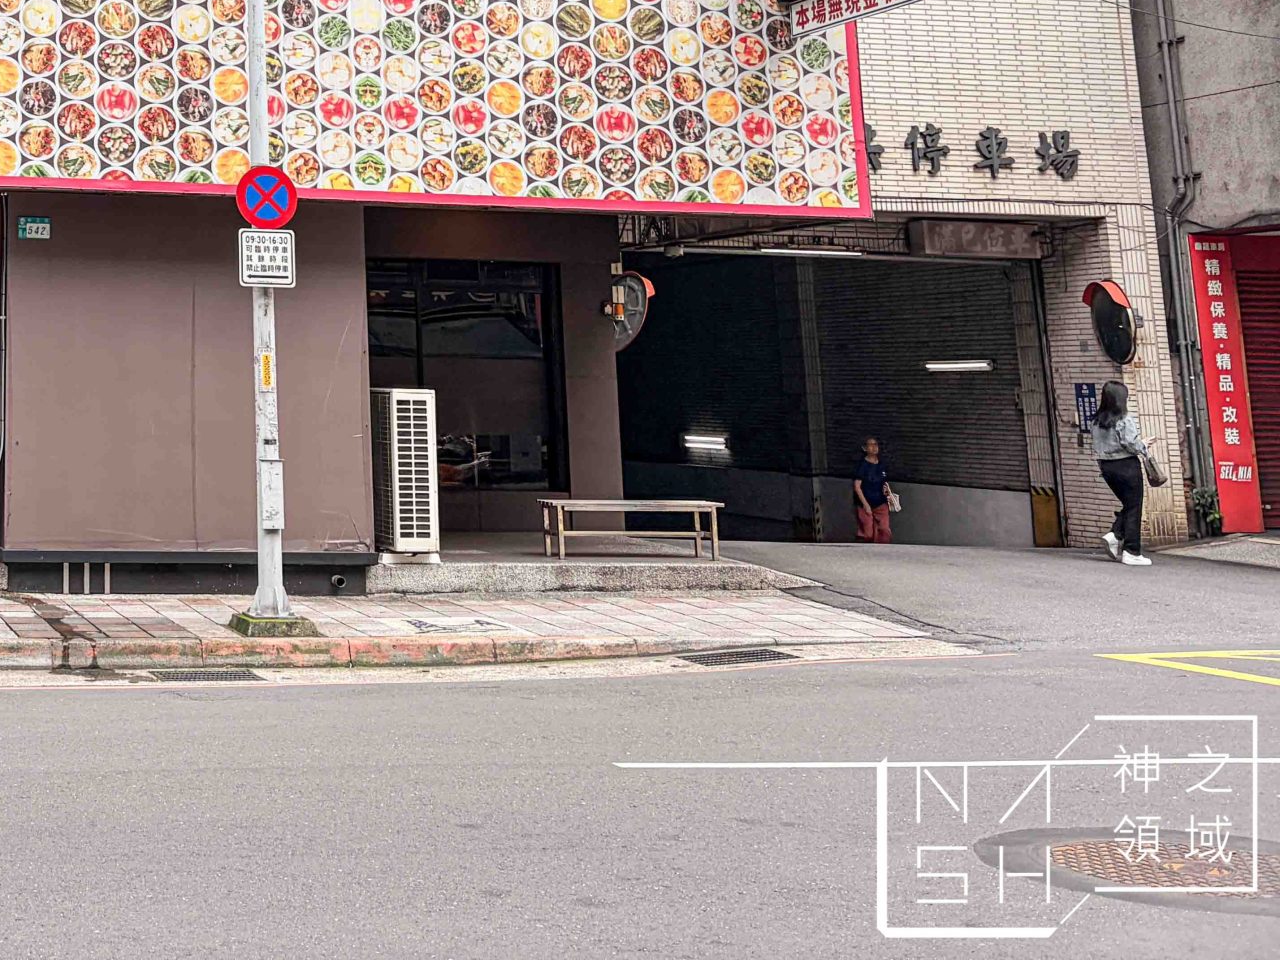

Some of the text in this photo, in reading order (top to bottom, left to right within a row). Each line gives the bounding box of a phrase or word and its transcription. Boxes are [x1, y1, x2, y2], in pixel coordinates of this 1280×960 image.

[27, 226, 46, 236] 542
[245, 235, 288, 245] 09:30-16:30
[246, 245, 288, 254] 可臨時停車
[246, 264, 289, 273] 禁止臨時停車
